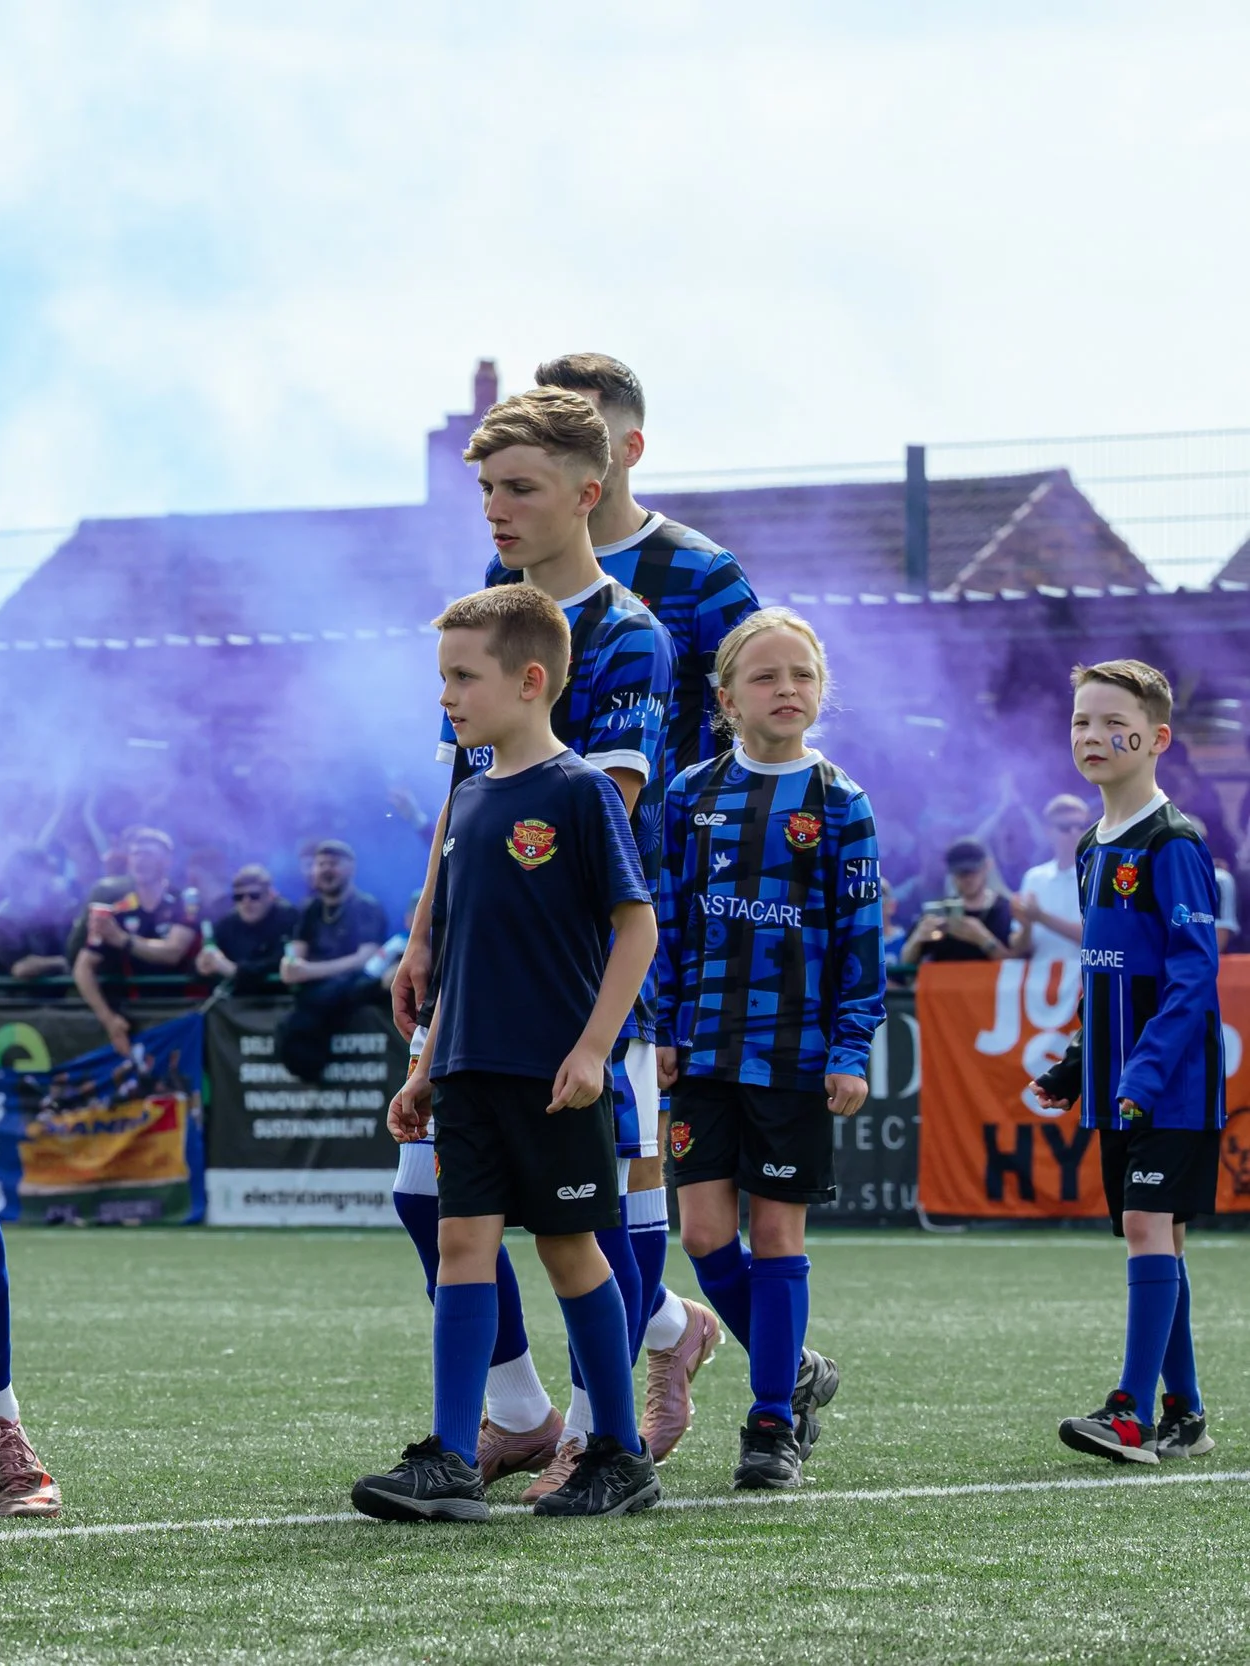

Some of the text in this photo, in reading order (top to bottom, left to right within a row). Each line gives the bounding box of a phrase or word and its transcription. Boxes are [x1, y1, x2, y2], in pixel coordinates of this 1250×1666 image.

[466, 745, 495, 766] VES
[694, 812, 728, 827] EV2
[243, 1089, 385, 1111] INNOVATION AND
[252, 1117, 377, 1139] SUSTAINABILITY
[762, 1162, 797, 1179] EV2
[556, 1183, 597, 1200] EV2
